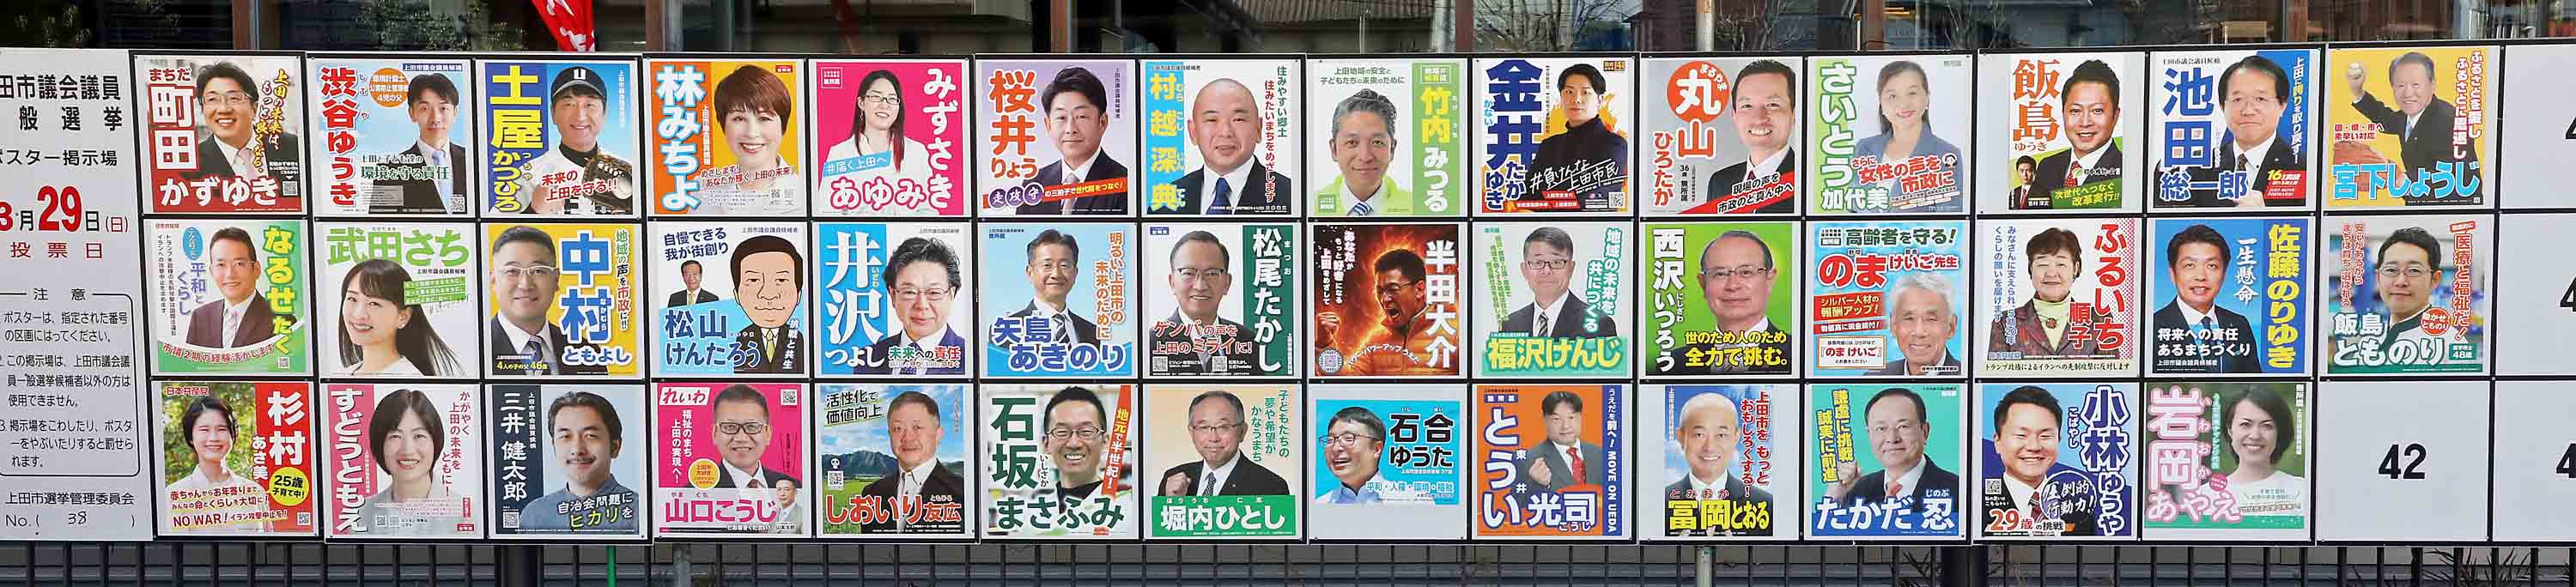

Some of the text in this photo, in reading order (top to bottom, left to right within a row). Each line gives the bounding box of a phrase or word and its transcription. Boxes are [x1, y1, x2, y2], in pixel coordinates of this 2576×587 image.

[149, 68, 191, 82] まちだ
[574, 69, 586, 80] U
[1334, 67, 1392, 76] 上田地域の安全と
[0, 75, 121, 100] 田市議会議員
[1277, 66, 1288, 138] 住みやすい郷土
[2013, 59, 2060, 142] 飯島
[149, 85, 197, 171] 町田
[989, 70, 1036, 155] 桜井
[1484, 100, 1494, 126] かない
[1485, 59, 1543, 170] 金井
[1675, 69, 1722, 158] 丸山
[1820, 62, 1856, 188] さいとう
[2163, 67, 2215, 168] 池田
[320, 67, 357, 206] 渋谷ゆうき
[489, 65, 544, 213] 土屋かつひろ
[655, 64, 707, 211] 林みちよ
[923, 69, 958, 209] みずさき
[1150, 73, 1177, 211] 村越深典
[1264, 80, 1276, 203] 住みたいまちをめざします
[1420, 87, 1452, 213] 竹内みつる
[2014, 142, 2047, 152] ゆうき
[361, 166, 449, 179] 環境を守る責任
[542, 170, 578, 185] 未来の
[991, 158, 1038, 179] りょう
[1653, 131, 1674, 206] ひろたか
[1851, 156, 1877, 168] さらに
[1859, 155, 1941, 185] 女性の声を
[160, 176, 278, 206] かずゆき
[831, 177, 927, 209] あゆみ
[1732, 172, 1781, 195] 現場の声を
[1901, 172, 1954, 194] 市政に
[2054, 183, 2116, 200] 次世代へつなぐ
[2160, 172, 2249, 202] 総一郎
[2332, 161, 2481, 201] 宮下しょうじ
[1718, 184, 1794, 214] 市政のど真ん中へ
[1821, 188, 1889, 211] 加代美
[10, 241, 103, 258] 投票日
[326, 227, 471, 268] 武田さち
[664, 227, 726, 246] 自慢できる
[665, 241, 729, 261] 我が街創り
[1845, 228, 1957, 245] 高齢者を守る!
[190, 262, 207, 304] 平和と
[1109, 232, 1124, 323] 明るい上田市の
[1604, 227, 1622, 316] 地域の未来を
[1819, 255, 1886, 287] のま
[2233, 237, 2260, 308] 一生懸命
[33, 287, 86, 301] 注意
[177, 271, 191, 316] くらし
[263, 226, 296, 354] なるせたく
[561, 233, 612, 341] 中村
[824, 231, 884, 344] 井沢
[1096, 260, 1109, 338] 未来のために
[1253, 227, 1283, 372] 松尾たかし
[1583, 259, 1603, 333] 共につくる
[1653, 228, 1685, 372] 西沢いつろう
[1820, 295, 1880, 307] シルバー人材の
[2094, 223, 2128, 351] ふるいち
[2267, 224, 2300, 368] 佐藤のりゆき
[1425, 239, 1457, 368] 半田大介
[4, 330, 111, 342] の区画にはってください。
[665, 309, 727, 339] 松山
[993, 317, 1052, 343] 矢島
[1153, 319, 1238, 336] ゲンバの声を
[1685, 330, 1787, 344] 世のため人のため
[2068, 302, 2093, 349] 順子
[2157, 328, 2239, 342] 将来への責任
[2333, 312, 2385, 336] 飯島
[7, 354, 131, 367] この掲示場は、上田市議会議
[563, 347, 630, 363] ともよし
[665, 341, 761, 368] けんたろう
[824, 346, 885, 368] つよし
[888, 345, 962, 360] 未来への責任
[1010, 343, 1125, 370] あきのり
[1487, 337, 1622, 370] 福沢けんじ
[1685, 347, 1788, 367] 全力で挑む。
[2157, 343, 2251, 356] あるまちづくり
[2333, 336, 2445, 366] とものり
[8, 374, 131, 387] 員一般選挙候補者以外の方は
[9, 394, 78, 407] 使用できません。
[663, 388, 706, 405] れいわ
[826, 390, 879, 408] 活性化で
[267, 390, 305, 465] 杉村
[826, 404, 882, 424] 価値向上
[1265, 397, 1276, 454] 夢や希望が
[1279, 390, 1290, 458] 子どもたちの
[1389, 414, 1454, 443] 石合
[2069, 408, 2081, 448] こばやし
[449, 402, 462, 470] 上田の未来を
[501, 392, 527, 502] 三井 健太郎
[683, 409, 693, 457] 福祉のまち
[991, 397, 1039, 490] 石坂
[1251, 405, 1261, 462] かなうまち
[1756, 391, 1771, 485] 上田市を もっと
[2148, 387, 2204, 493] 岩岡
[12, 456, 43, 468] れます。
[252, 436, 269, 481] あさ美
[331, 388, 368, 532] すどうともえ
[1390, 446, 1453, 467] ゆうた
[1484, 408, 1521, 529] とうい
[2083, 388, 2130, 535] 小林ゆうや
[2379, 443, 2427, 480] 42
[274, 475, 303, 488] 25歳
[1608, 451, 1617, 533] MOVE ON UEDA
[1670, 489, 1729, 499] とみおか
[2043, 480, 2090, 500] 圧倒的
[5, 492, 134, 505] 上田市選挙管理委員会
[558, 492, 633, 514] 自治会問題に
[665, 499, 778, 523] 山口こうじ
[826, 494, 923, 525] しおいり
[923, 501, 962, 522] 友広
[997, 496, 1125, 530] まさふみ
[1528, 493, 1596, 527] 光司
[1816, 496, 1955, 530] たかだ 忍
[2148, 491, 2244, 523] あやえ
[173, 515, 191, 527] NO
[569, 506, 633, 528] ヒカリを
[1161, 505, 1285, 530] 堀内ひとし
